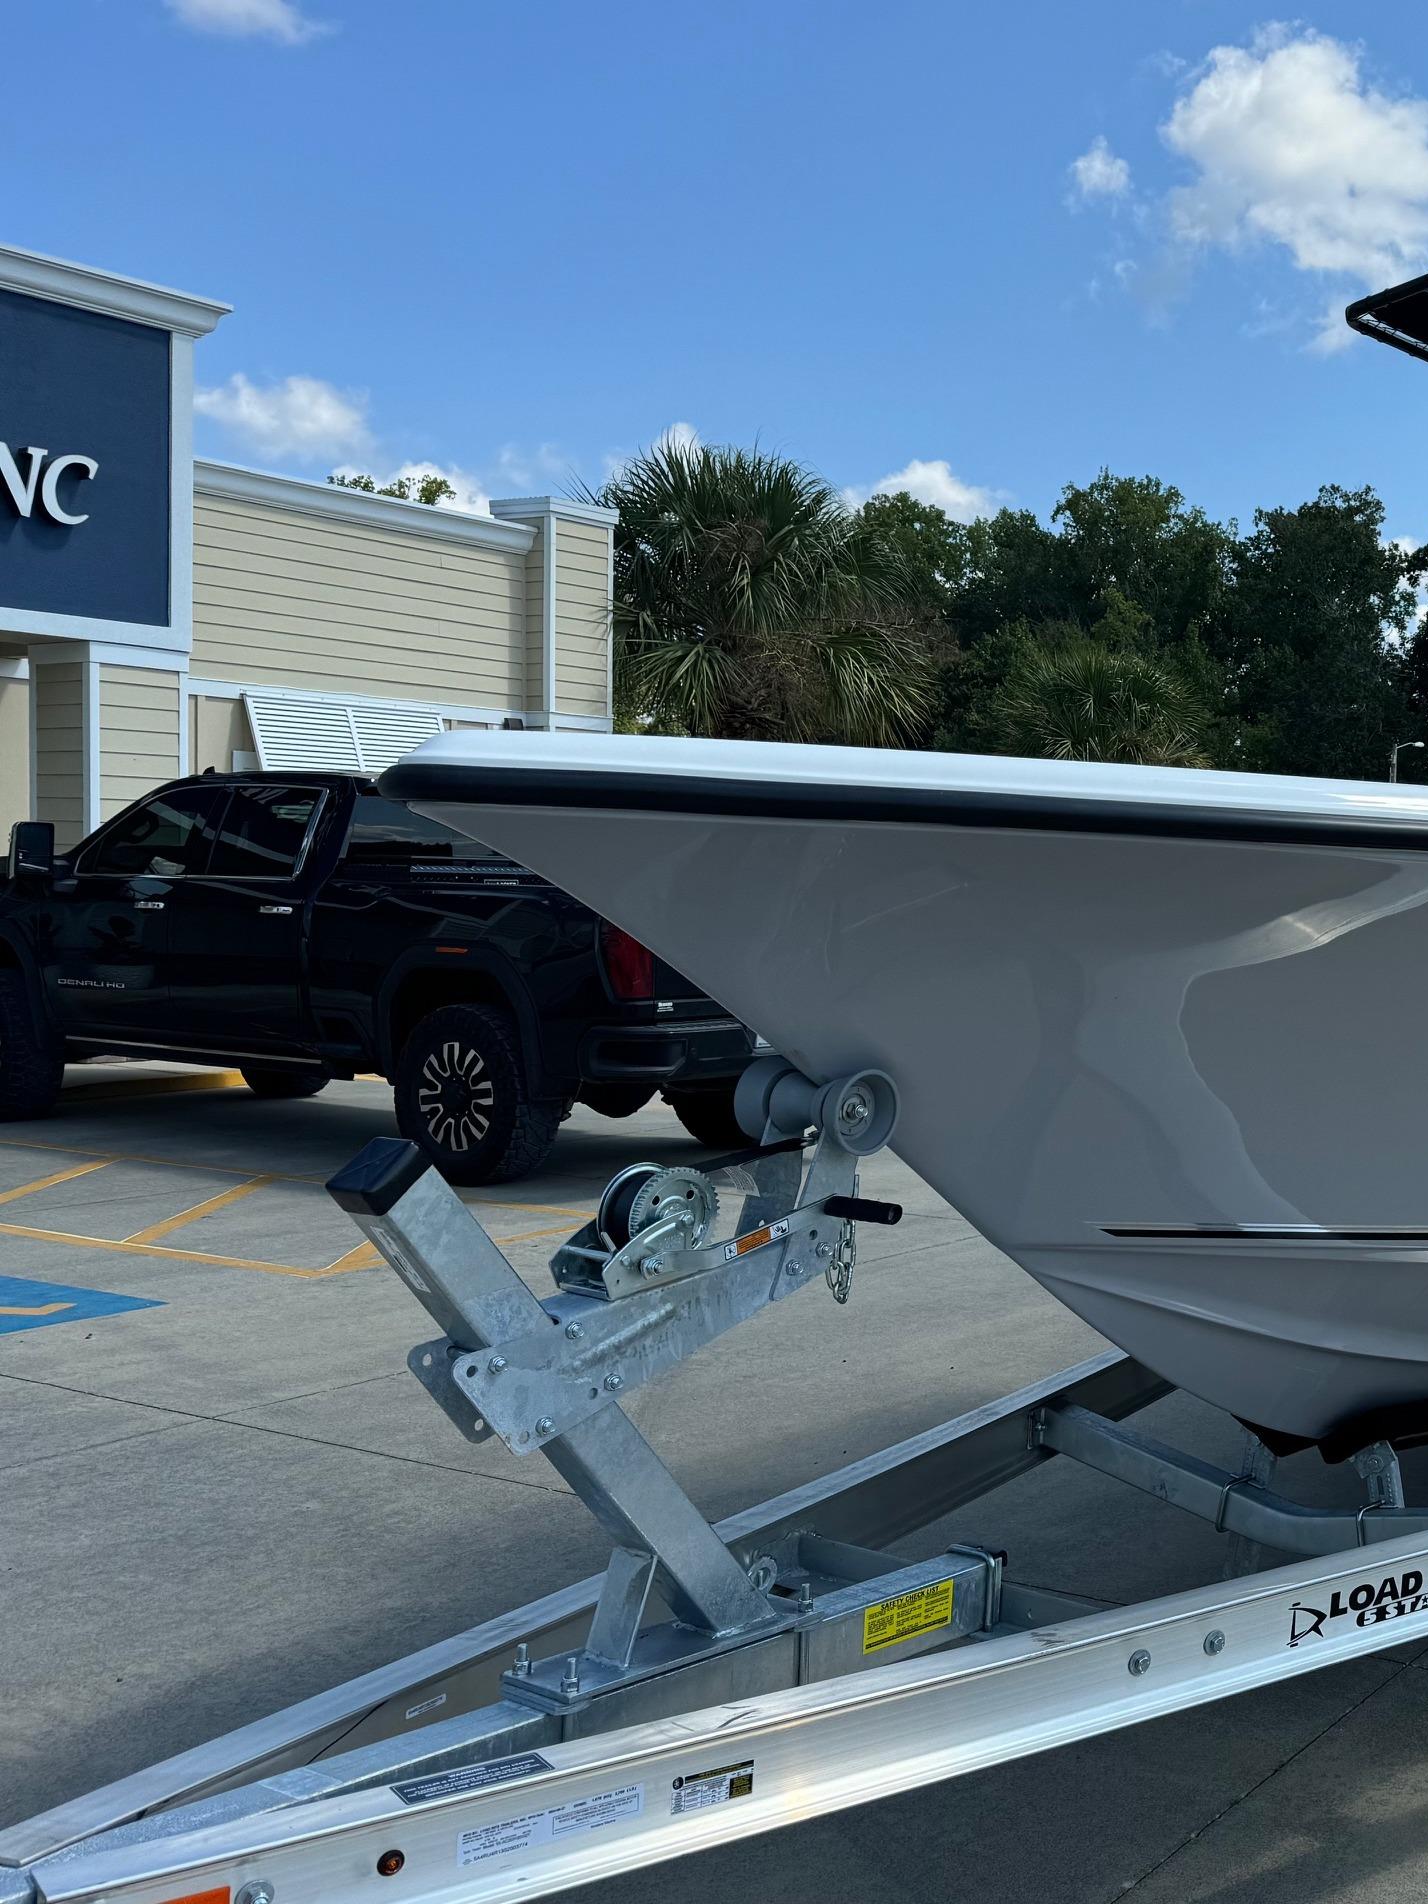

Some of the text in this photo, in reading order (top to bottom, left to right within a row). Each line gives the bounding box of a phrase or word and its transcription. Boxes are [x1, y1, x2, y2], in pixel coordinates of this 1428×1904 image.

[57, 978, 126, 989] DENALI HD
[880, 1585, 940, 1610] SAFETY CHECK LIST
[1329, 1570, 1423, 1618] LOAD
[1363, 1609, 1377, 1626] 5
